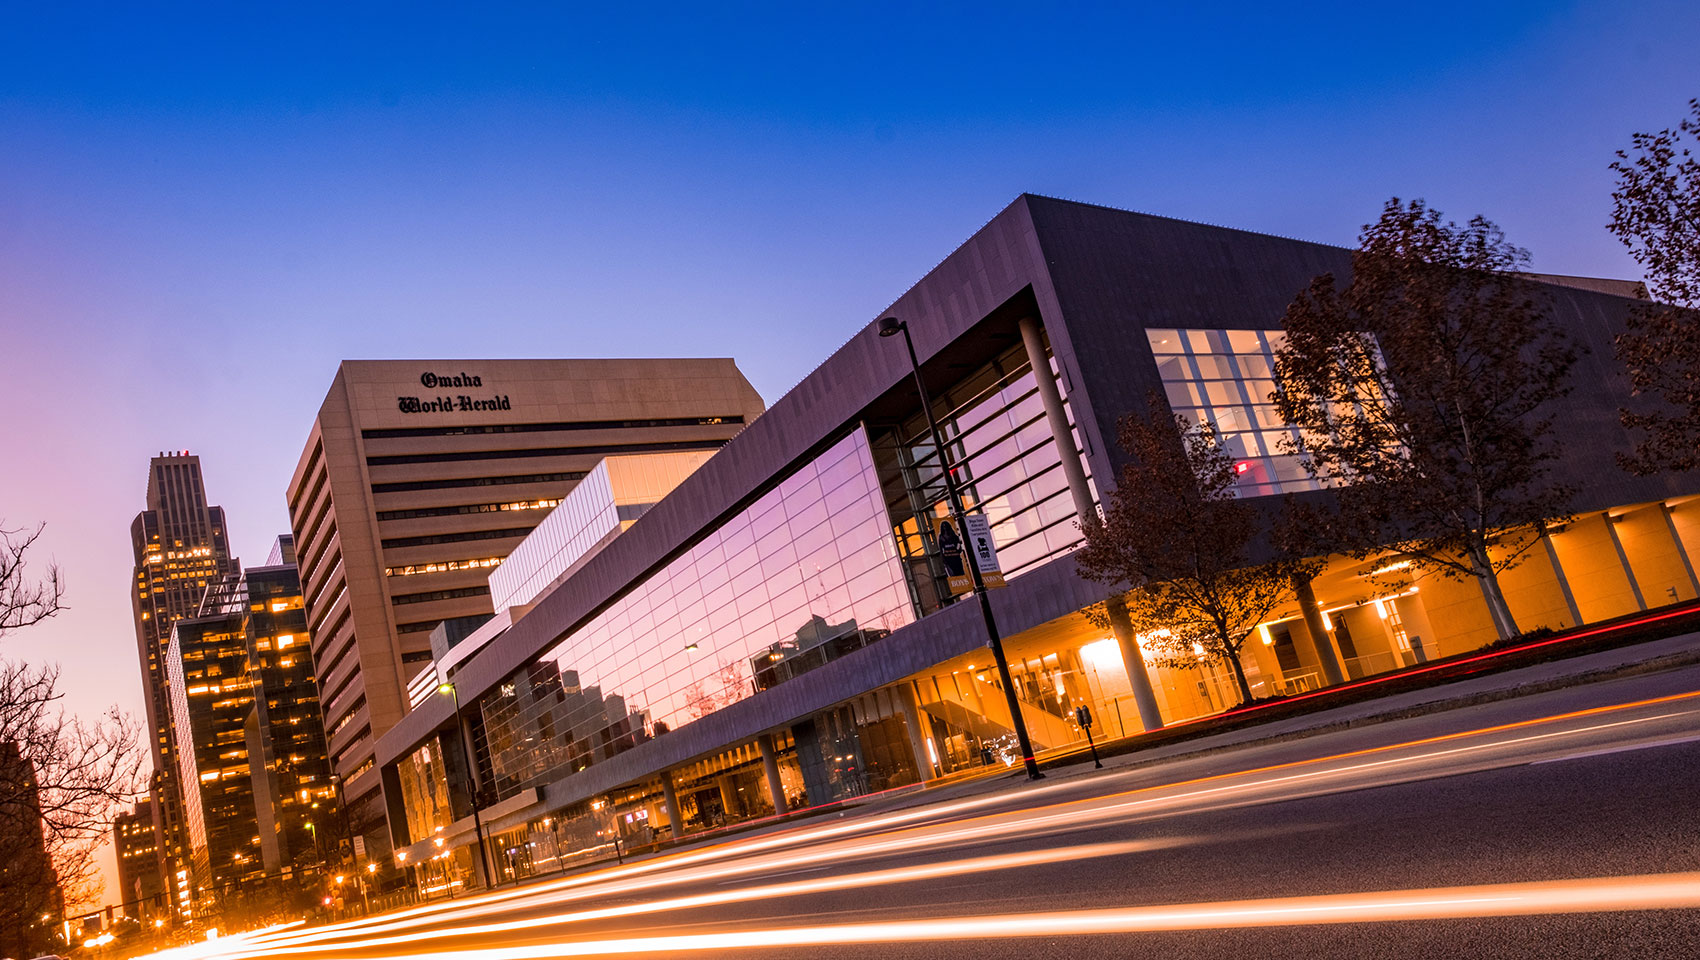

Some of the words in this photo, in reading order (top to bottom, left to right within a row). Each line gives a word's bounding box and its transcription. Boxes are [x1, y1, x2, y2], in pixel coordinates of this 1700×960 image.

[420, 372, 482, 388] Omaha
[398, 395, 511, 413] World-Herald
[951, 579, 969, 587] BOYS
